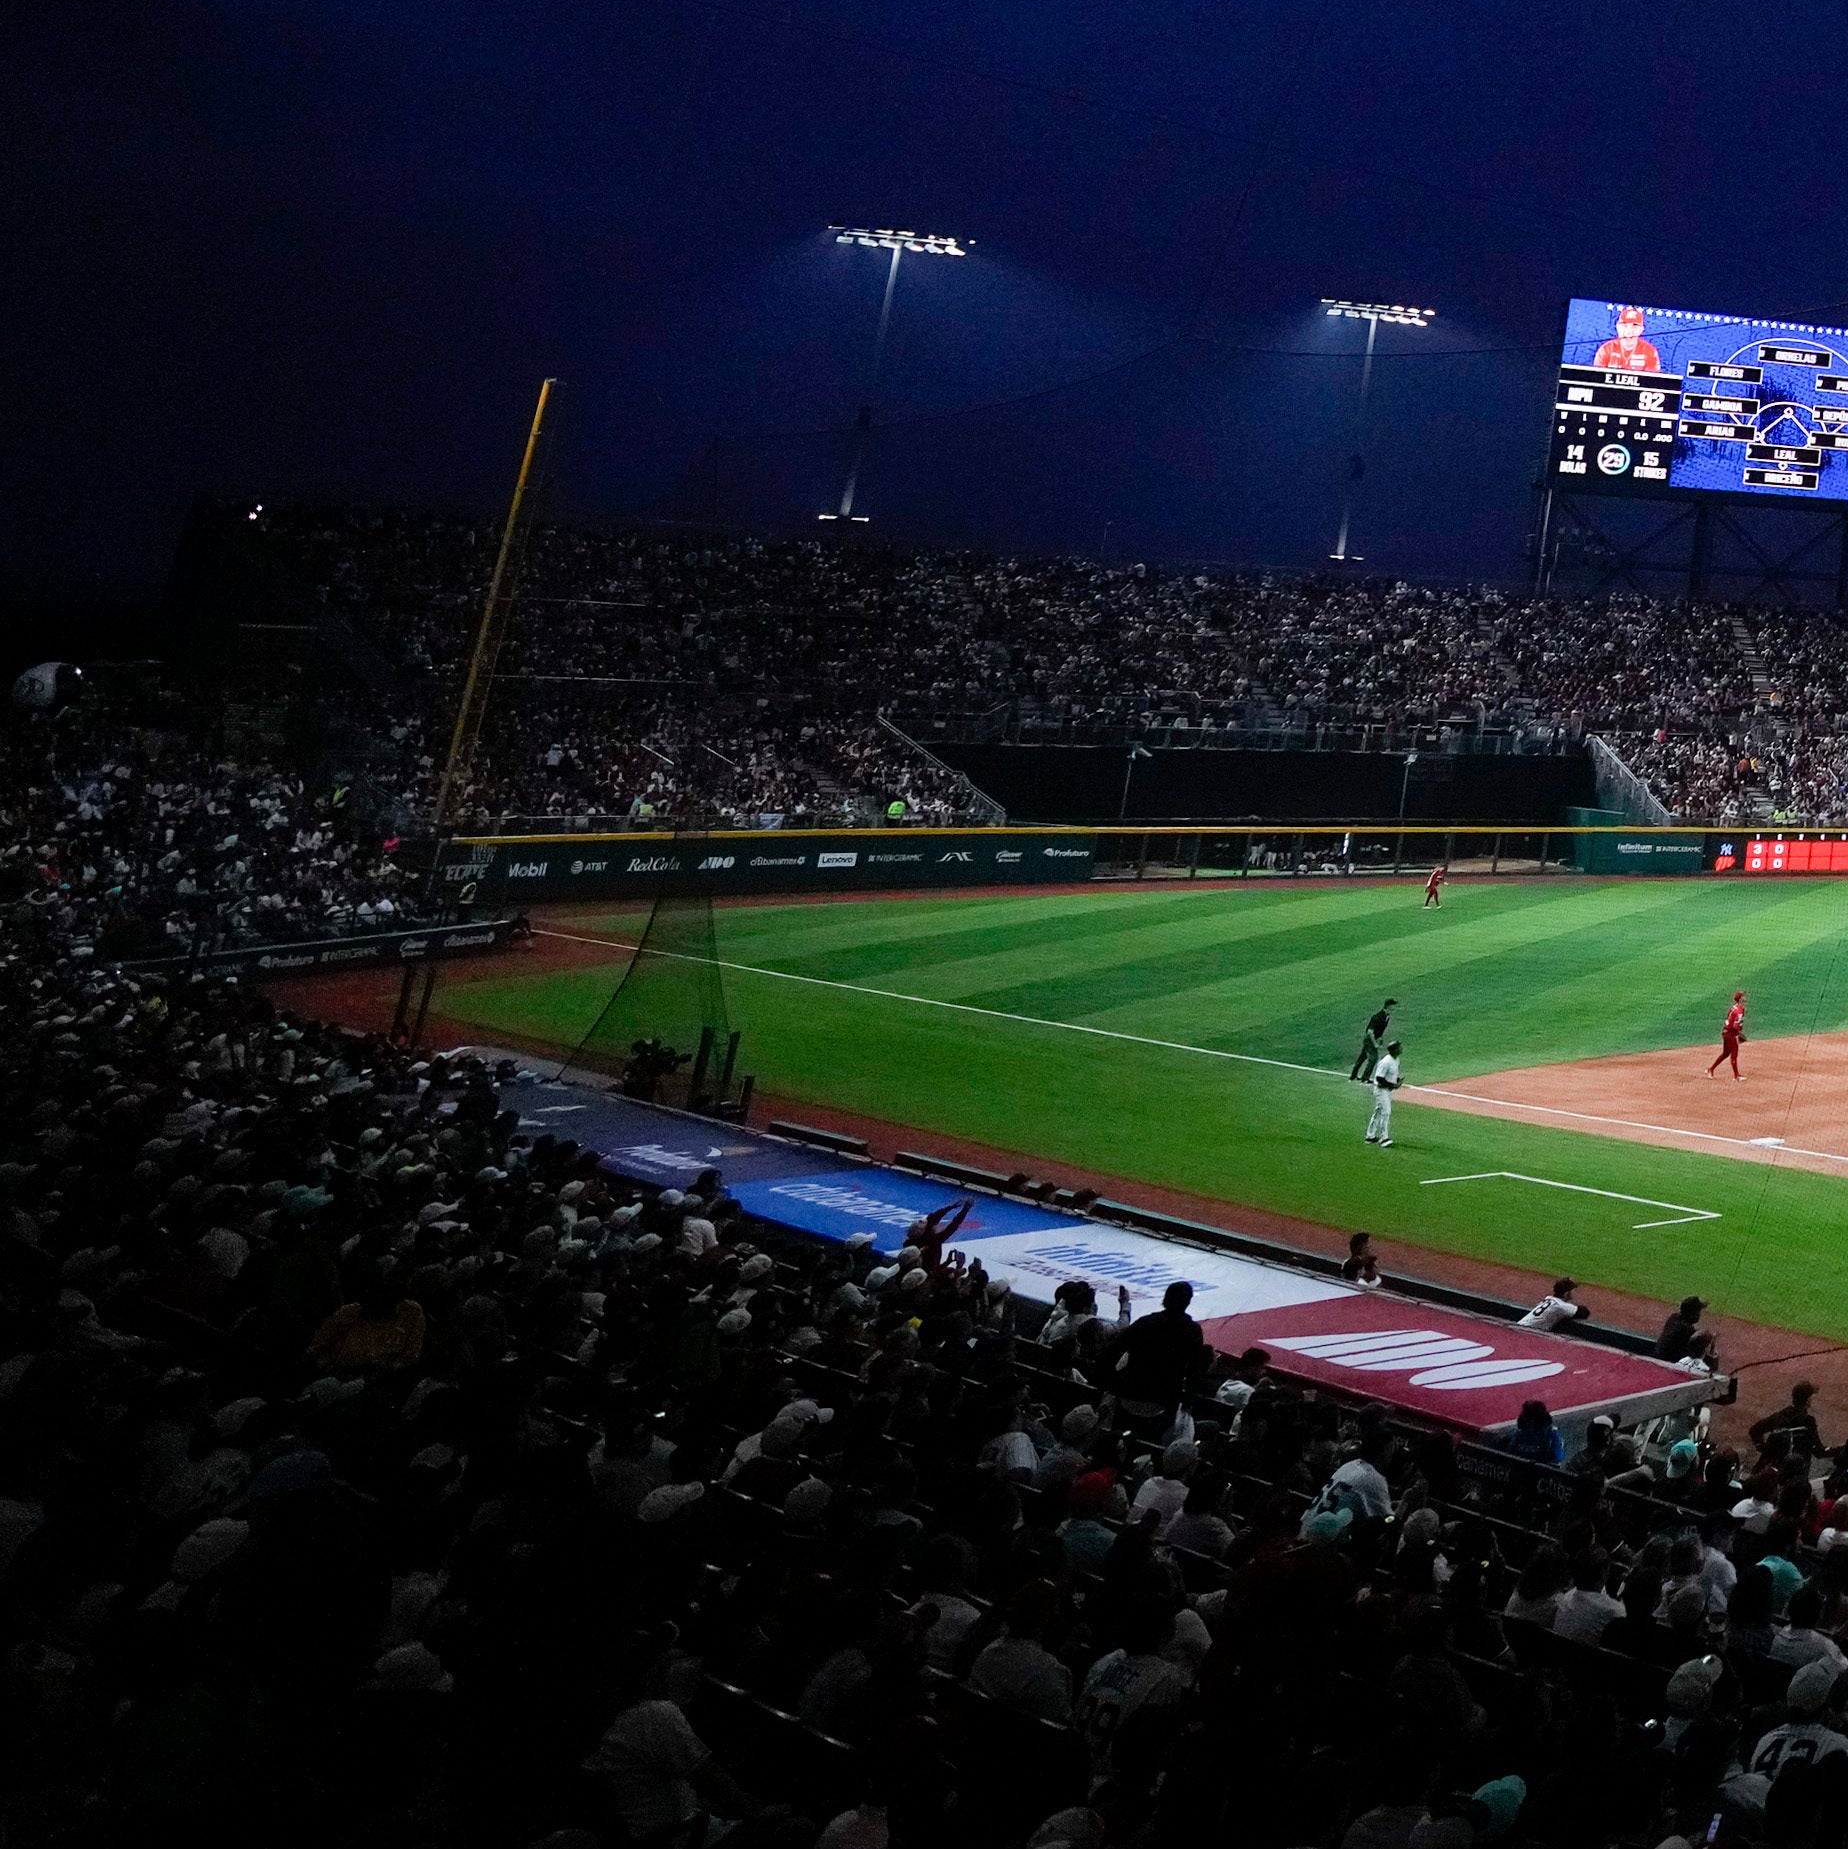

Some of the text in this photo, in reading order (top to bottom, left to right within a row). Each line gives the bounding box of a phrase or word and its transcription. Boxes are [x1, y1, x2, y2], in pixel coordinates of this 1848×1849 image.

[1710, 367, 1744, 379] FLORES
[1605, 374, 1641, 387] E. LEAL
[1638, 391, 1666, 412] 92
[1558, 425, 1566, 435] 0
[1578, 427, 1586, 437] 0
[1597, 429, 1605, 439] 0
[1617, 431, 1625, 441] 0
[1705, 426, 1735, 437] ARIAS
[1567, 445, 1585, 461] 14
[1643, 451, 1660, 467] 15
[1775, 449, 1798, 461] LEAL
[1603, 451, 1626, 469] 29
[1559, 461, 1588, 474] BOLAS
[1633, 466, 1668, 480] STRIKES
[1753, 844, 1762, 854] 3
[1774, 844, 1784, 854] 0
[584, 861, 609, 871] AT&T
[822, 855, 854, 864] Lenovo
[1752, 858, 1761, 868] 0
[1773, 858, 1783, 868] 0
